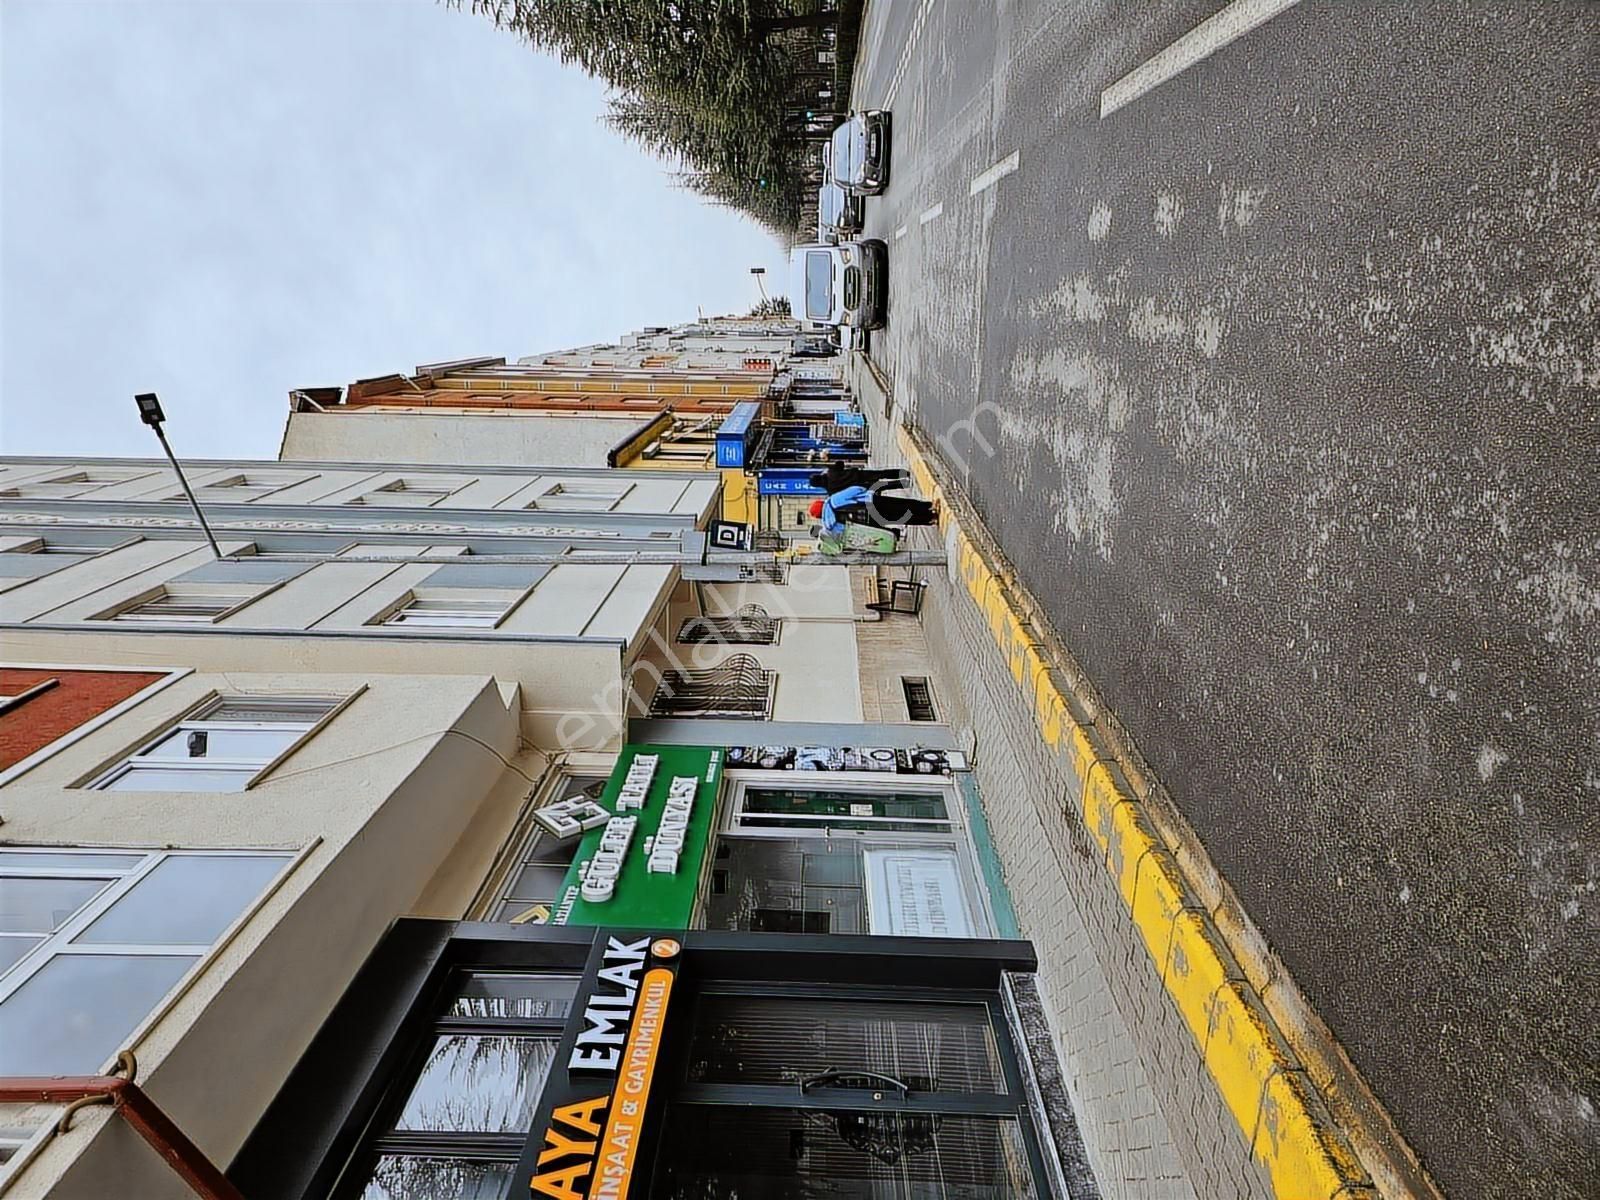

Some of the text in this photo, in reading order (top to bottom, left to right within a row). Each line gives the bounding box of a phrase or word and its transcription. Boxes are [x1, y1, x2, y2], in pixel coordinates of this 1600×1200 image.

[720, 529, 735, 541] D
[578, 754, 659, 902] GÜLER TATLI
[643, 776, 698, 875] DÜNYASI
[568, 936, 650, 1070] EMLAK
[592, 980, 666, 1200] İNŞAAT & GAYRİMENKUL
